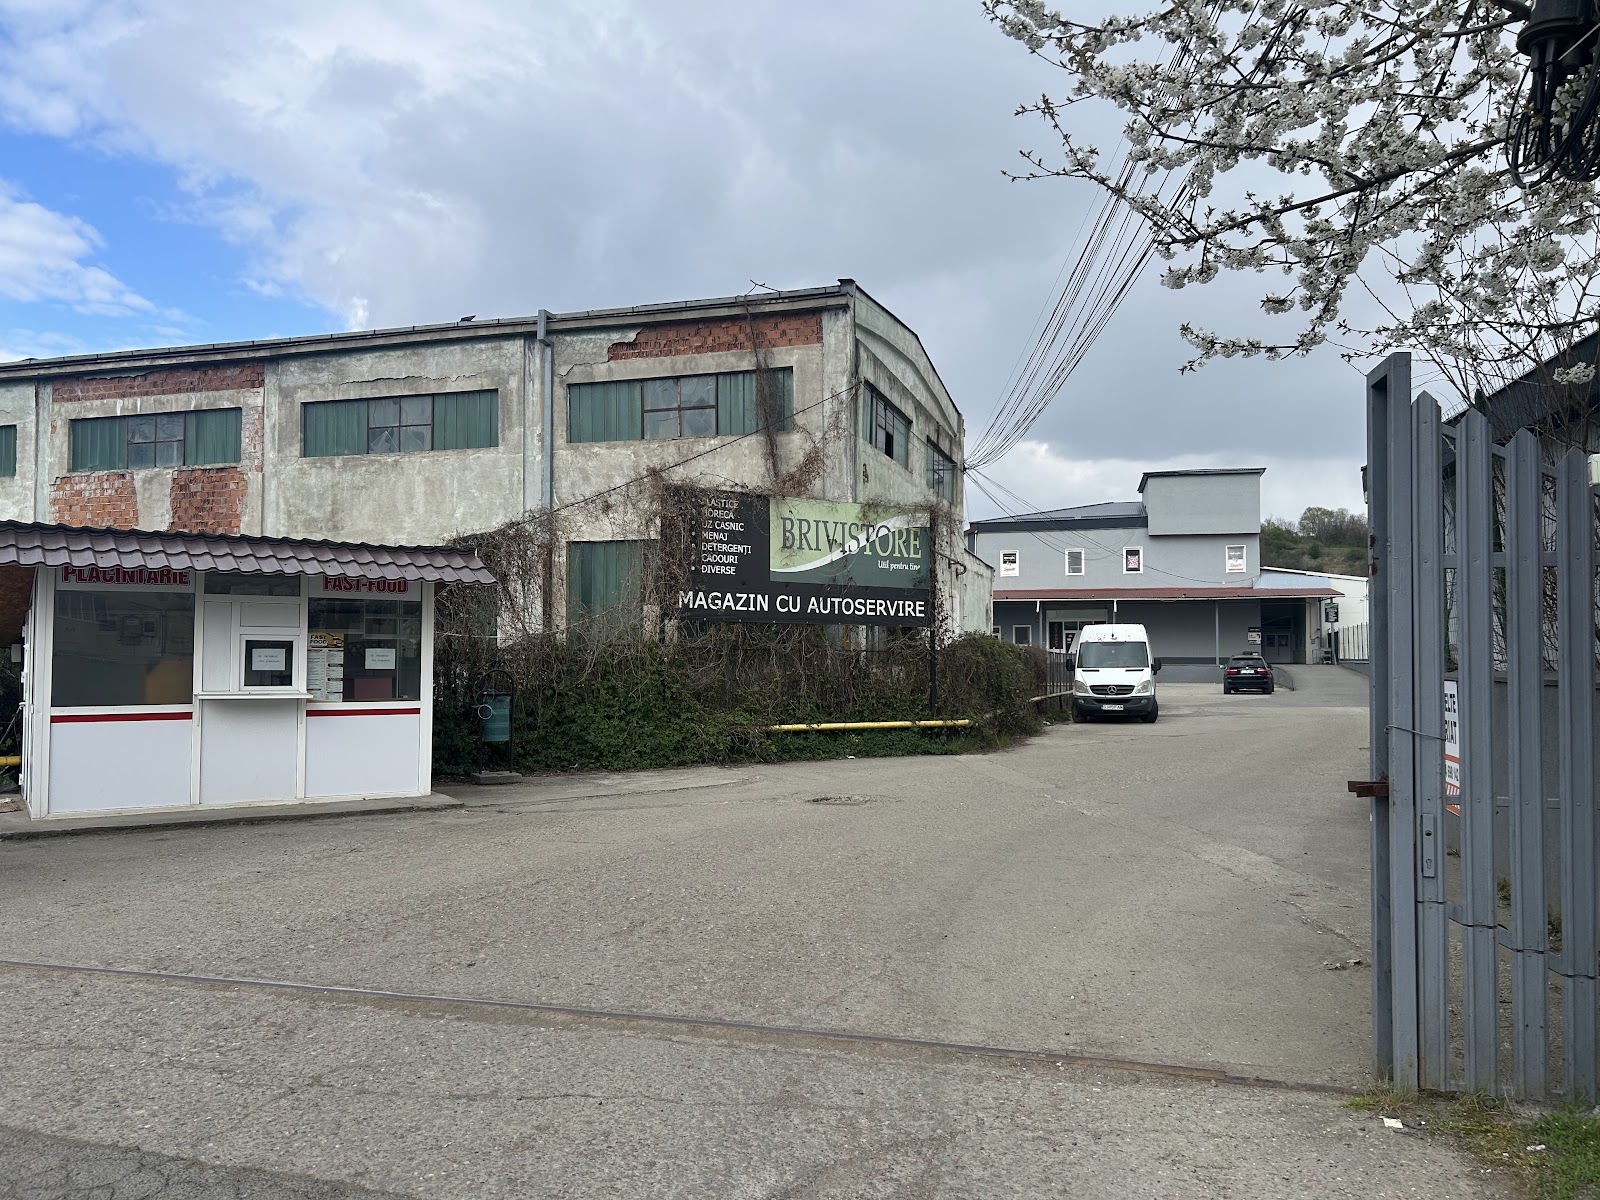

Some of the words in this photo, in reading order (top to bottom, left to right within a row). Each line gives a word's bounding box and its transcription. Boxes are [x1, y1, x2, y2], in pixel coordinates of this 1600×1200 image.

[714, 521, 745, 531] CASNIC
[702, 531, 728, 541] MENAJ
[780, 516, 922, 559] BRIVISTORE
[701, 553, 739, 564] CADOURI
[701, 564, 736, 575] DIVERSE
[889, 562, 909, 572] pentru
[678, 591, 769, 612] MAGAZIN
[775, 595, 801, 613] CU
[806, 597, 926, 617] AUTOSERVIRE
